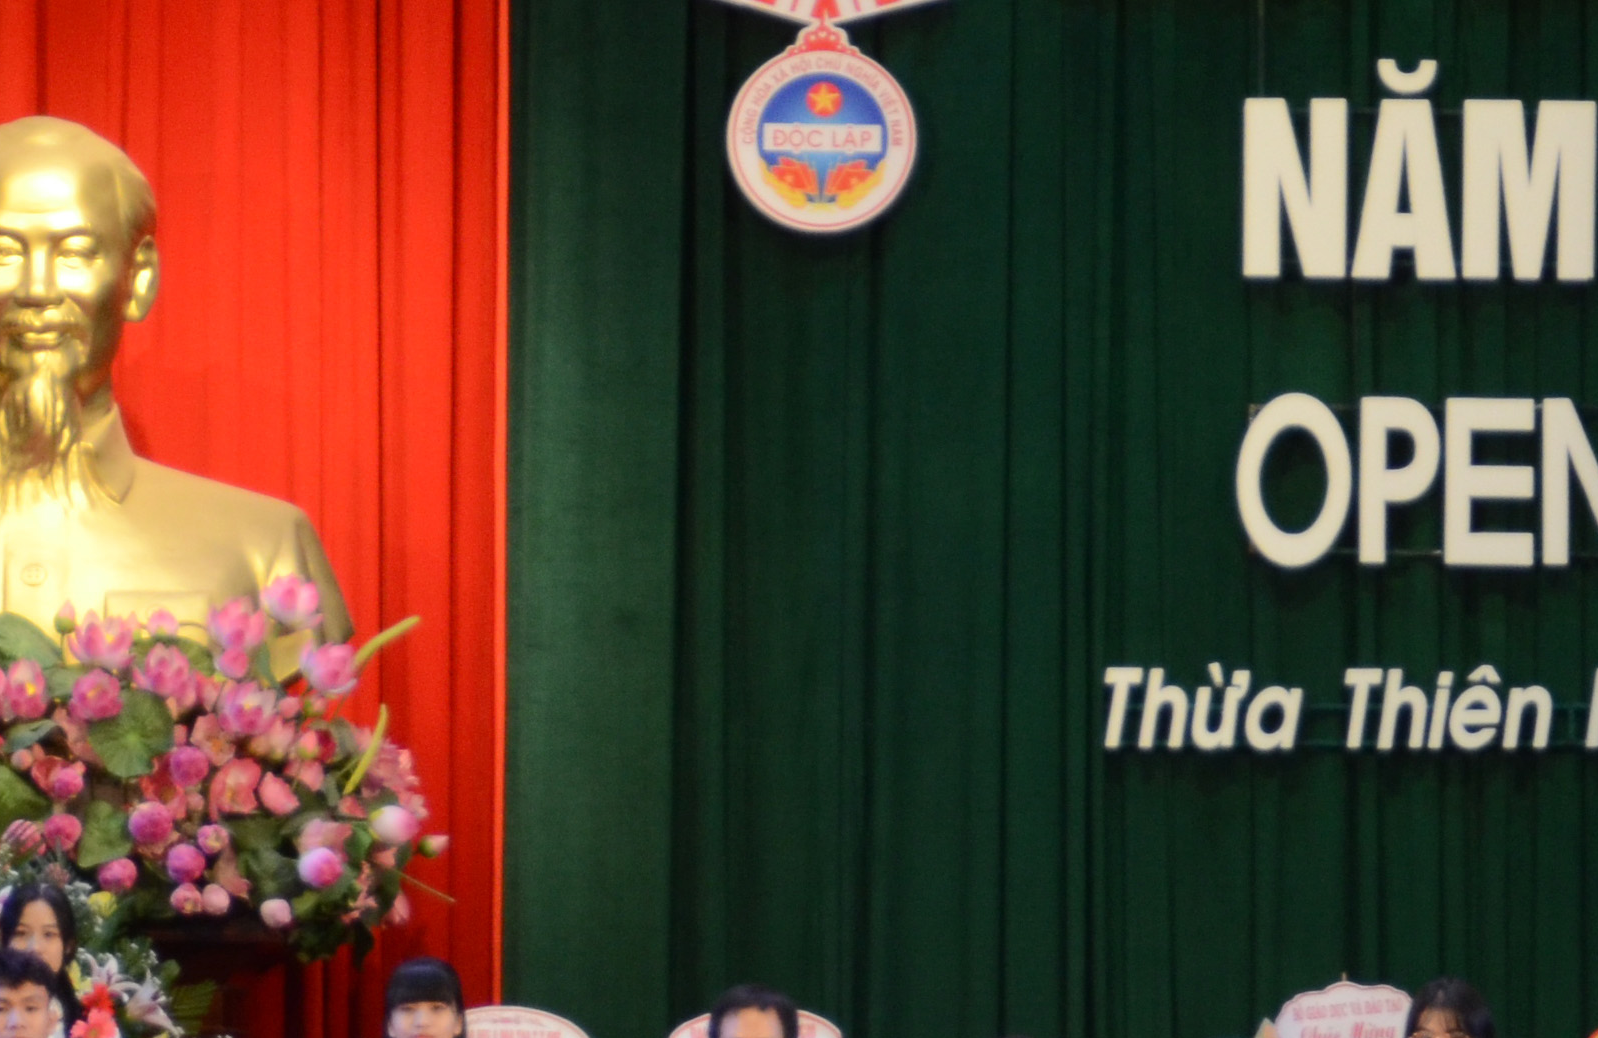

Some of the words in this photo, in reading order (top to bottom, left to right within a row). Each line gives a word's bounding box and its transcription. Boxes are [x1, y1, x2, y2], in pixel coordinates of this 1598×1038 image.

[772, 124, 823, 152] ĐỘC
[832, 125, 872, 152] LẬP
[1242, 59, 1598, 282] NĂM
[1103, 661, 1304, 752] Thừa
[1343, 664, 1553, 751] Thiên
